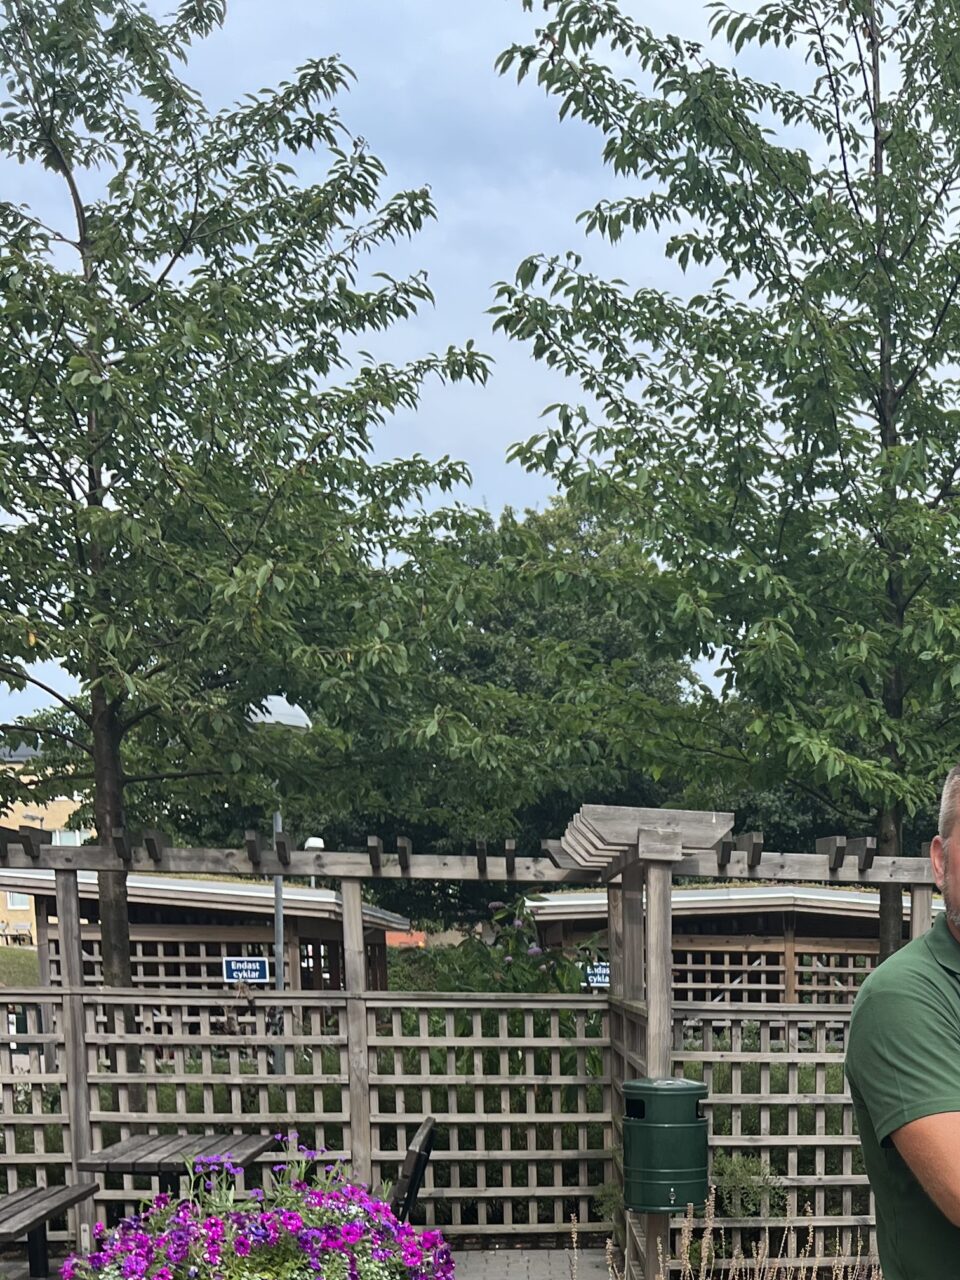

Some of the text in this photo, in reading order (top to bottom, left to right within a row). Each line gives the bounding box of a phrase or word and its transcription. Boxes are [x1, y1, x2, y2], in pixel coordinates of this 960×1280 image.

[231, 960, 261, 970] Endast
[586, 965, 610, 974] Endas
[232, 970, 260, 980] cyklar
[588, 974, 610, 983] cykla
